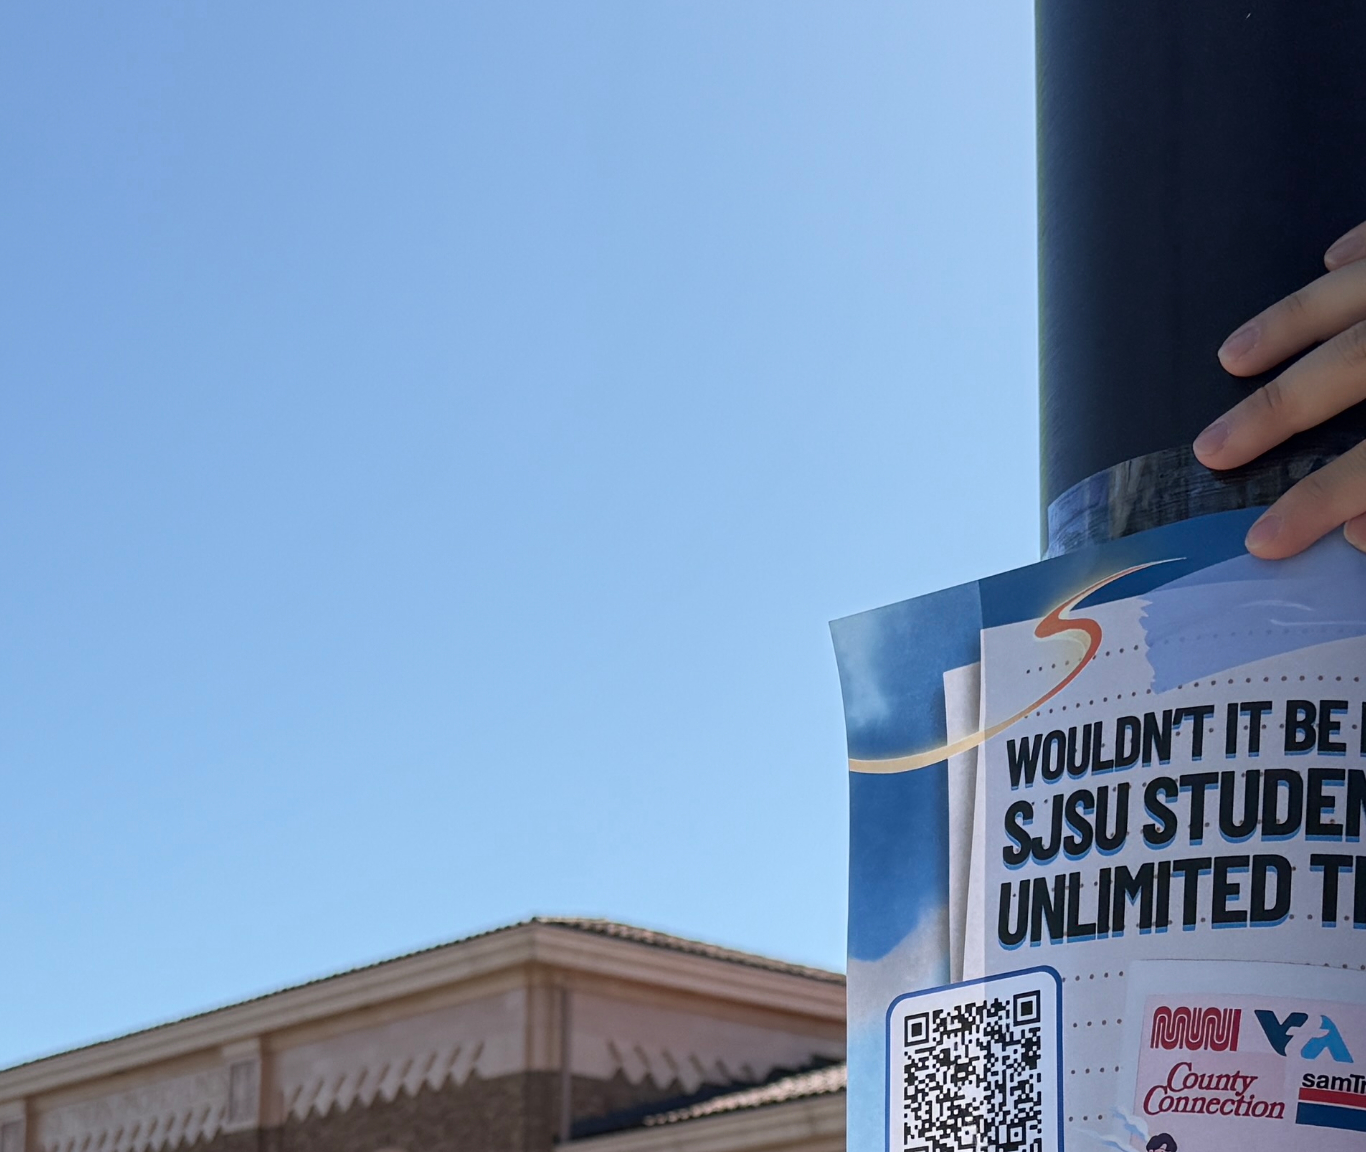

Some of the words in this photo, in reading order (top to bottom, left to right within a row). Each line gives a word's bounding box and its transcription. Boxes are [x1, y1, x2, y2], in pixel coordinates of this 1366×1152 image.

[1006, 704, 1214, 788] WOULDN'T
[1225, 701, 1273, 756] IT
[1284, 699, 1347, 754] BE
[1003, 782, 1130, 867] SJSU
[998, 854, 1293, 949] UNLIMITED
[1143, 1085, 1286, 1120] Connection
[1167, 1061, 1259, 1097] County
